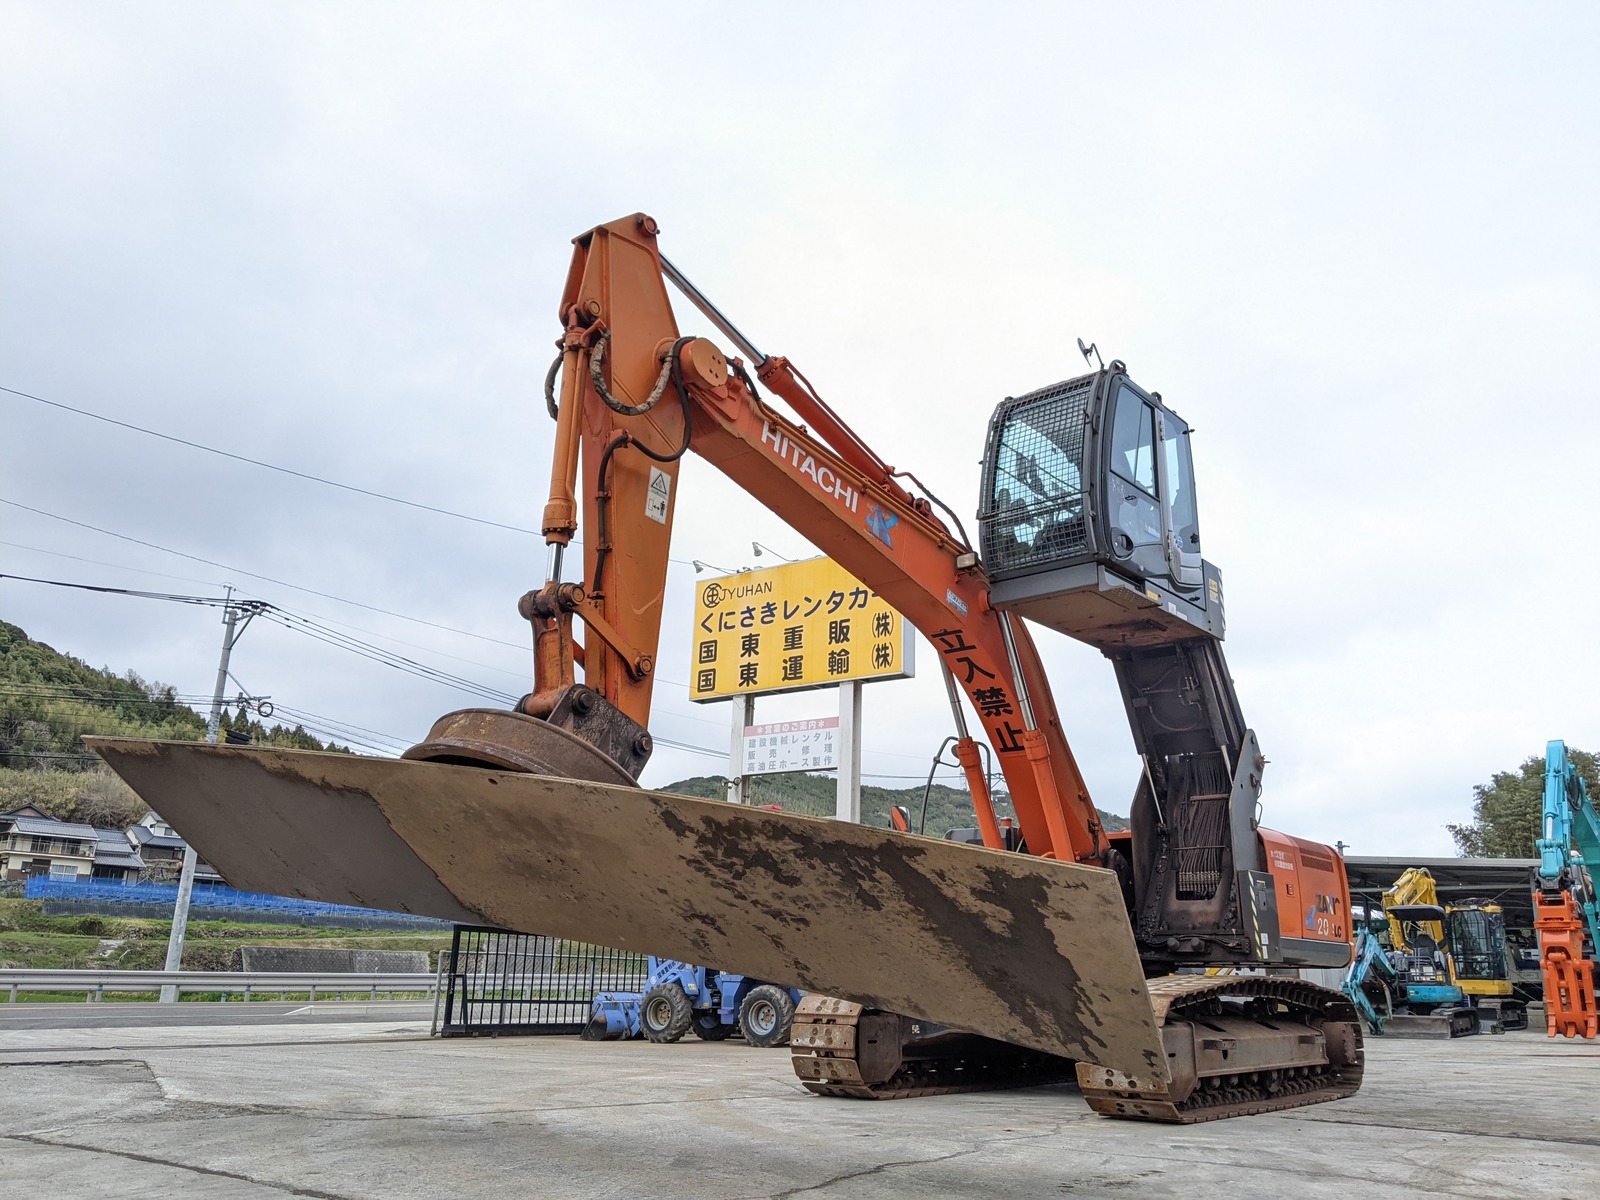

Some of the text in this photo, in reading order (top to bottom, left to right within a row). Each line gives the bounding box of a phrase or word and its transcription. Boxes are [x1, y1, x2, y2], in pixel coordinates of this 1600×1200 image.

[761, 420, 859, 513] HITACHI
[719, 581, 773, 602] JYUHAN
[931, 628, 1026, 753] 立入禁止
[748, 731, 833, 749] 建設機械レンタル
